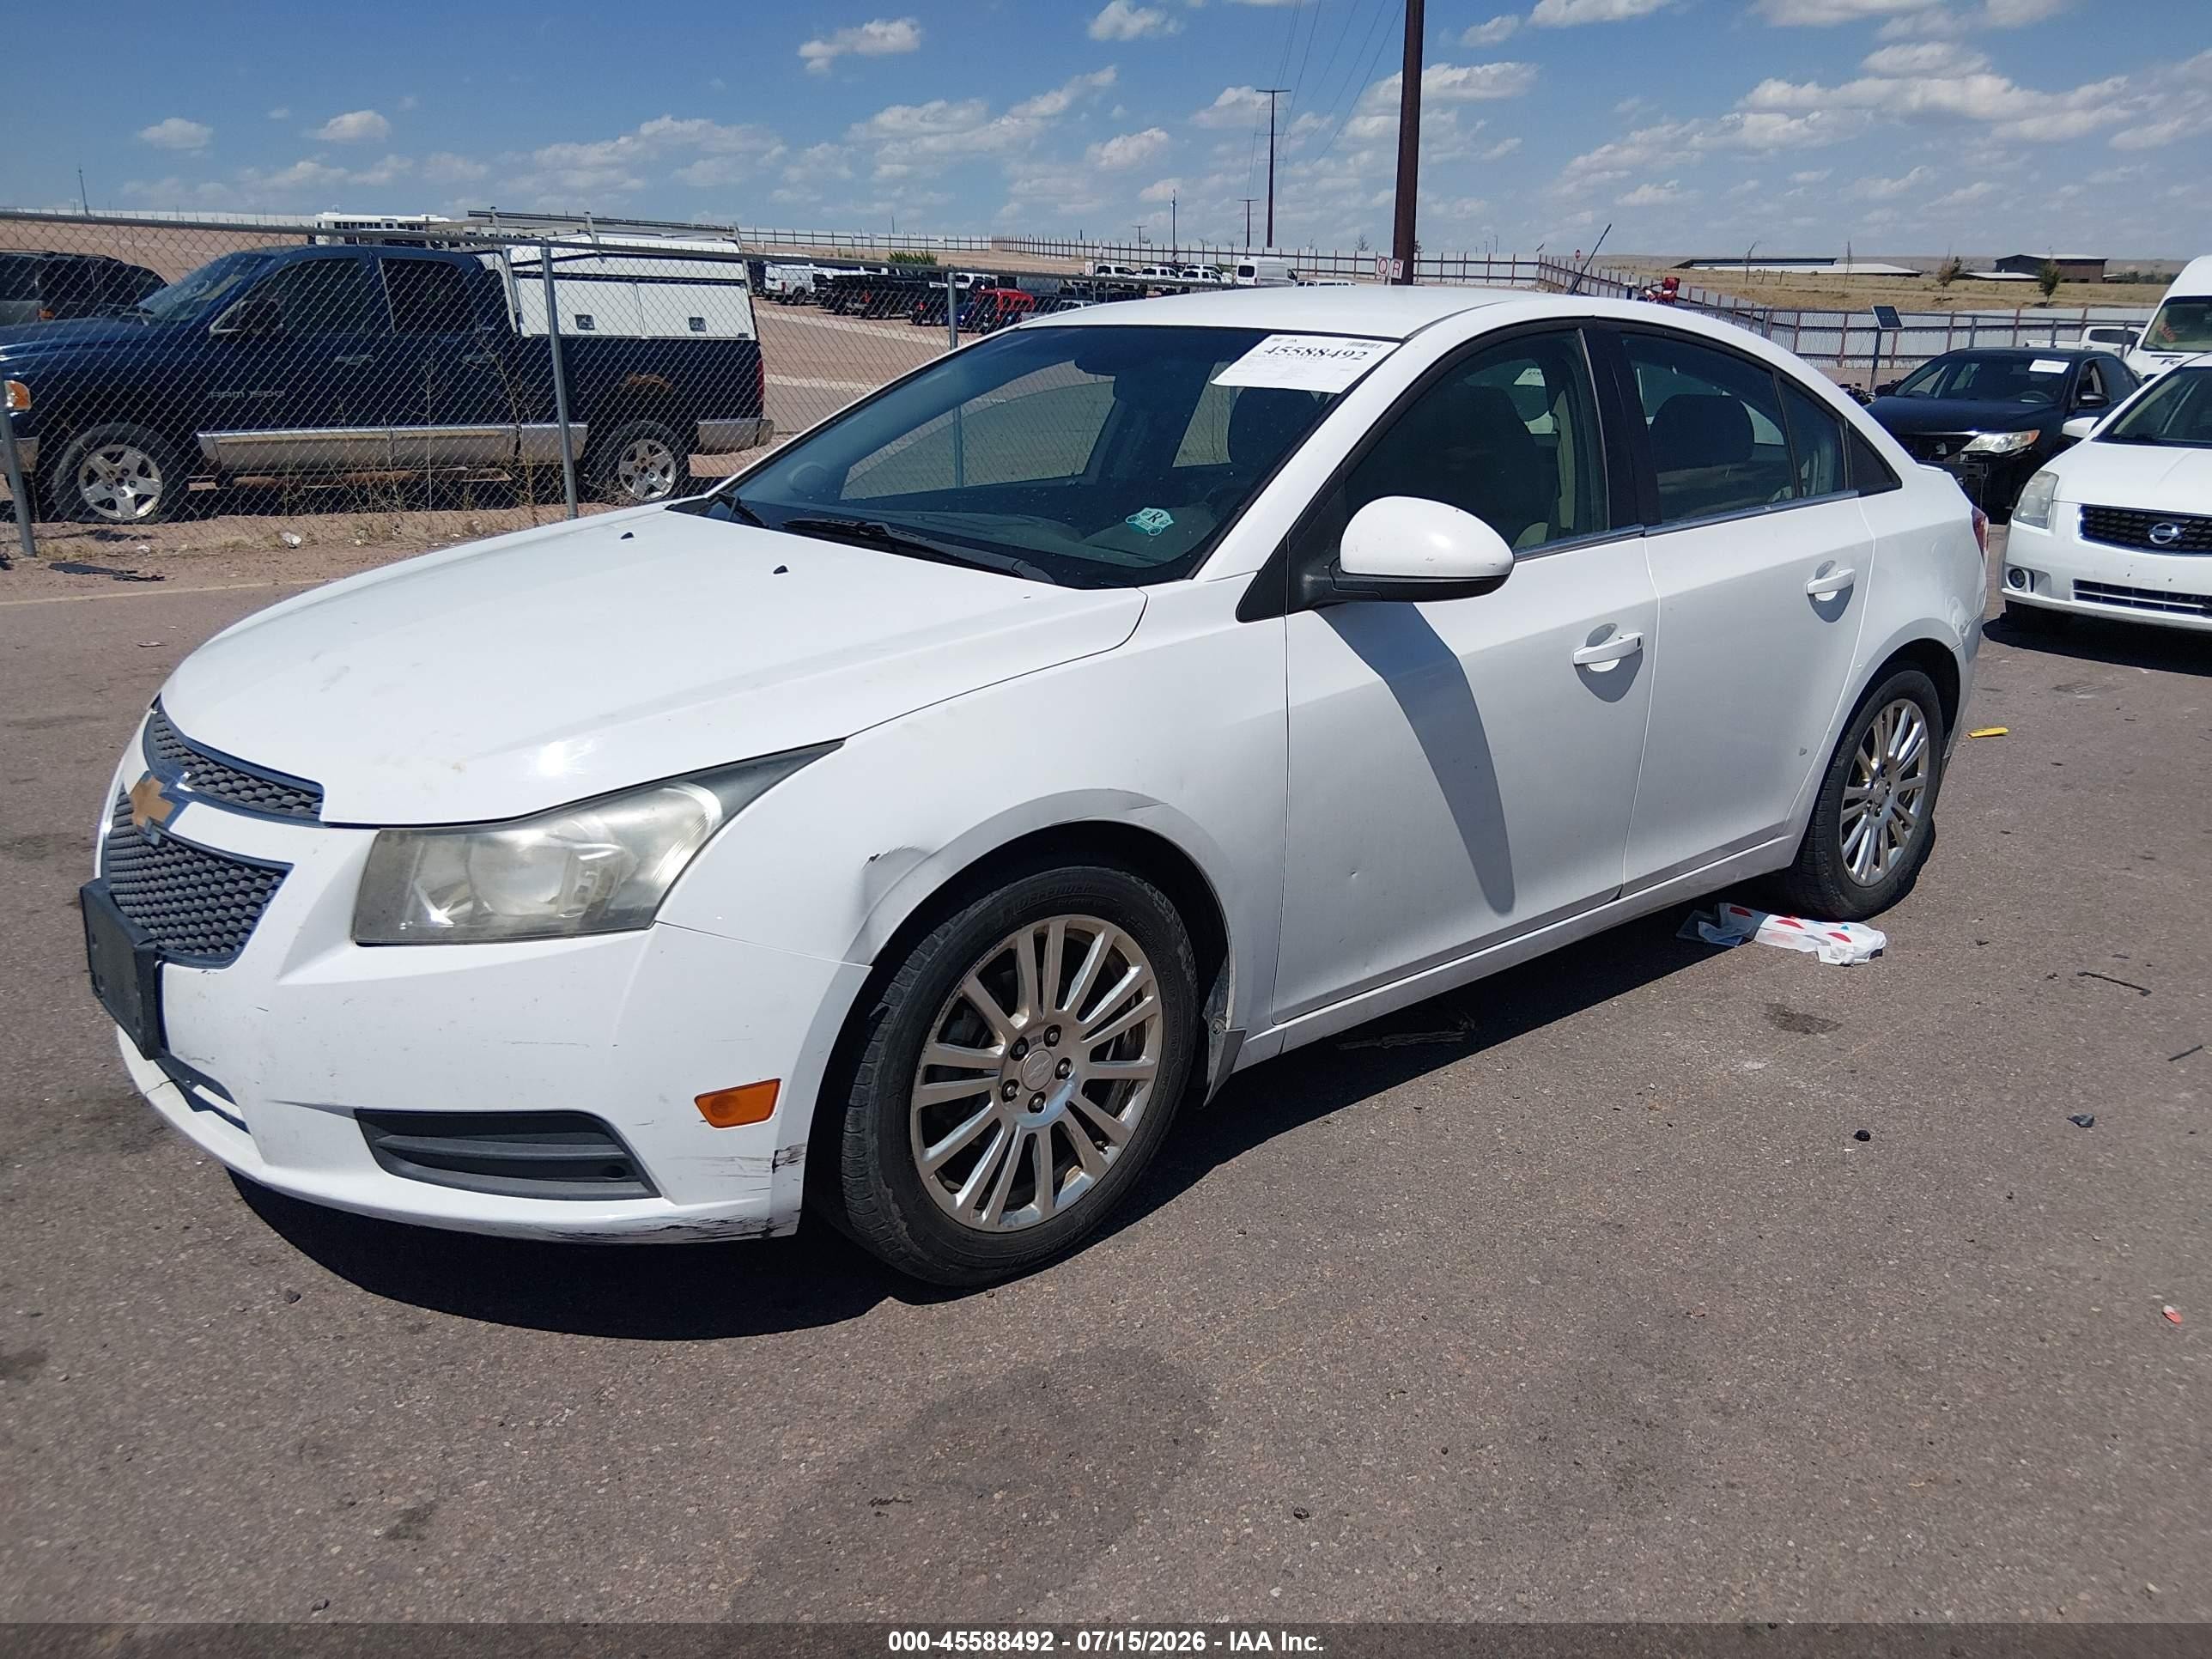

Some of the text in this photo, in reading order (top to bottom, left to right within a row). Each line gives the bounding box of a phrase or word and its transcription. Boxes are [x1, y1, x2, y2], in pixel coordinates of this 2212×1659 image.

[1378, 258, 1388, 274] Q
[1392, 261, 1401, 276] R
[1263, 345, 1369, 361] 45588492
[1146, 512, 1164, 523] R
